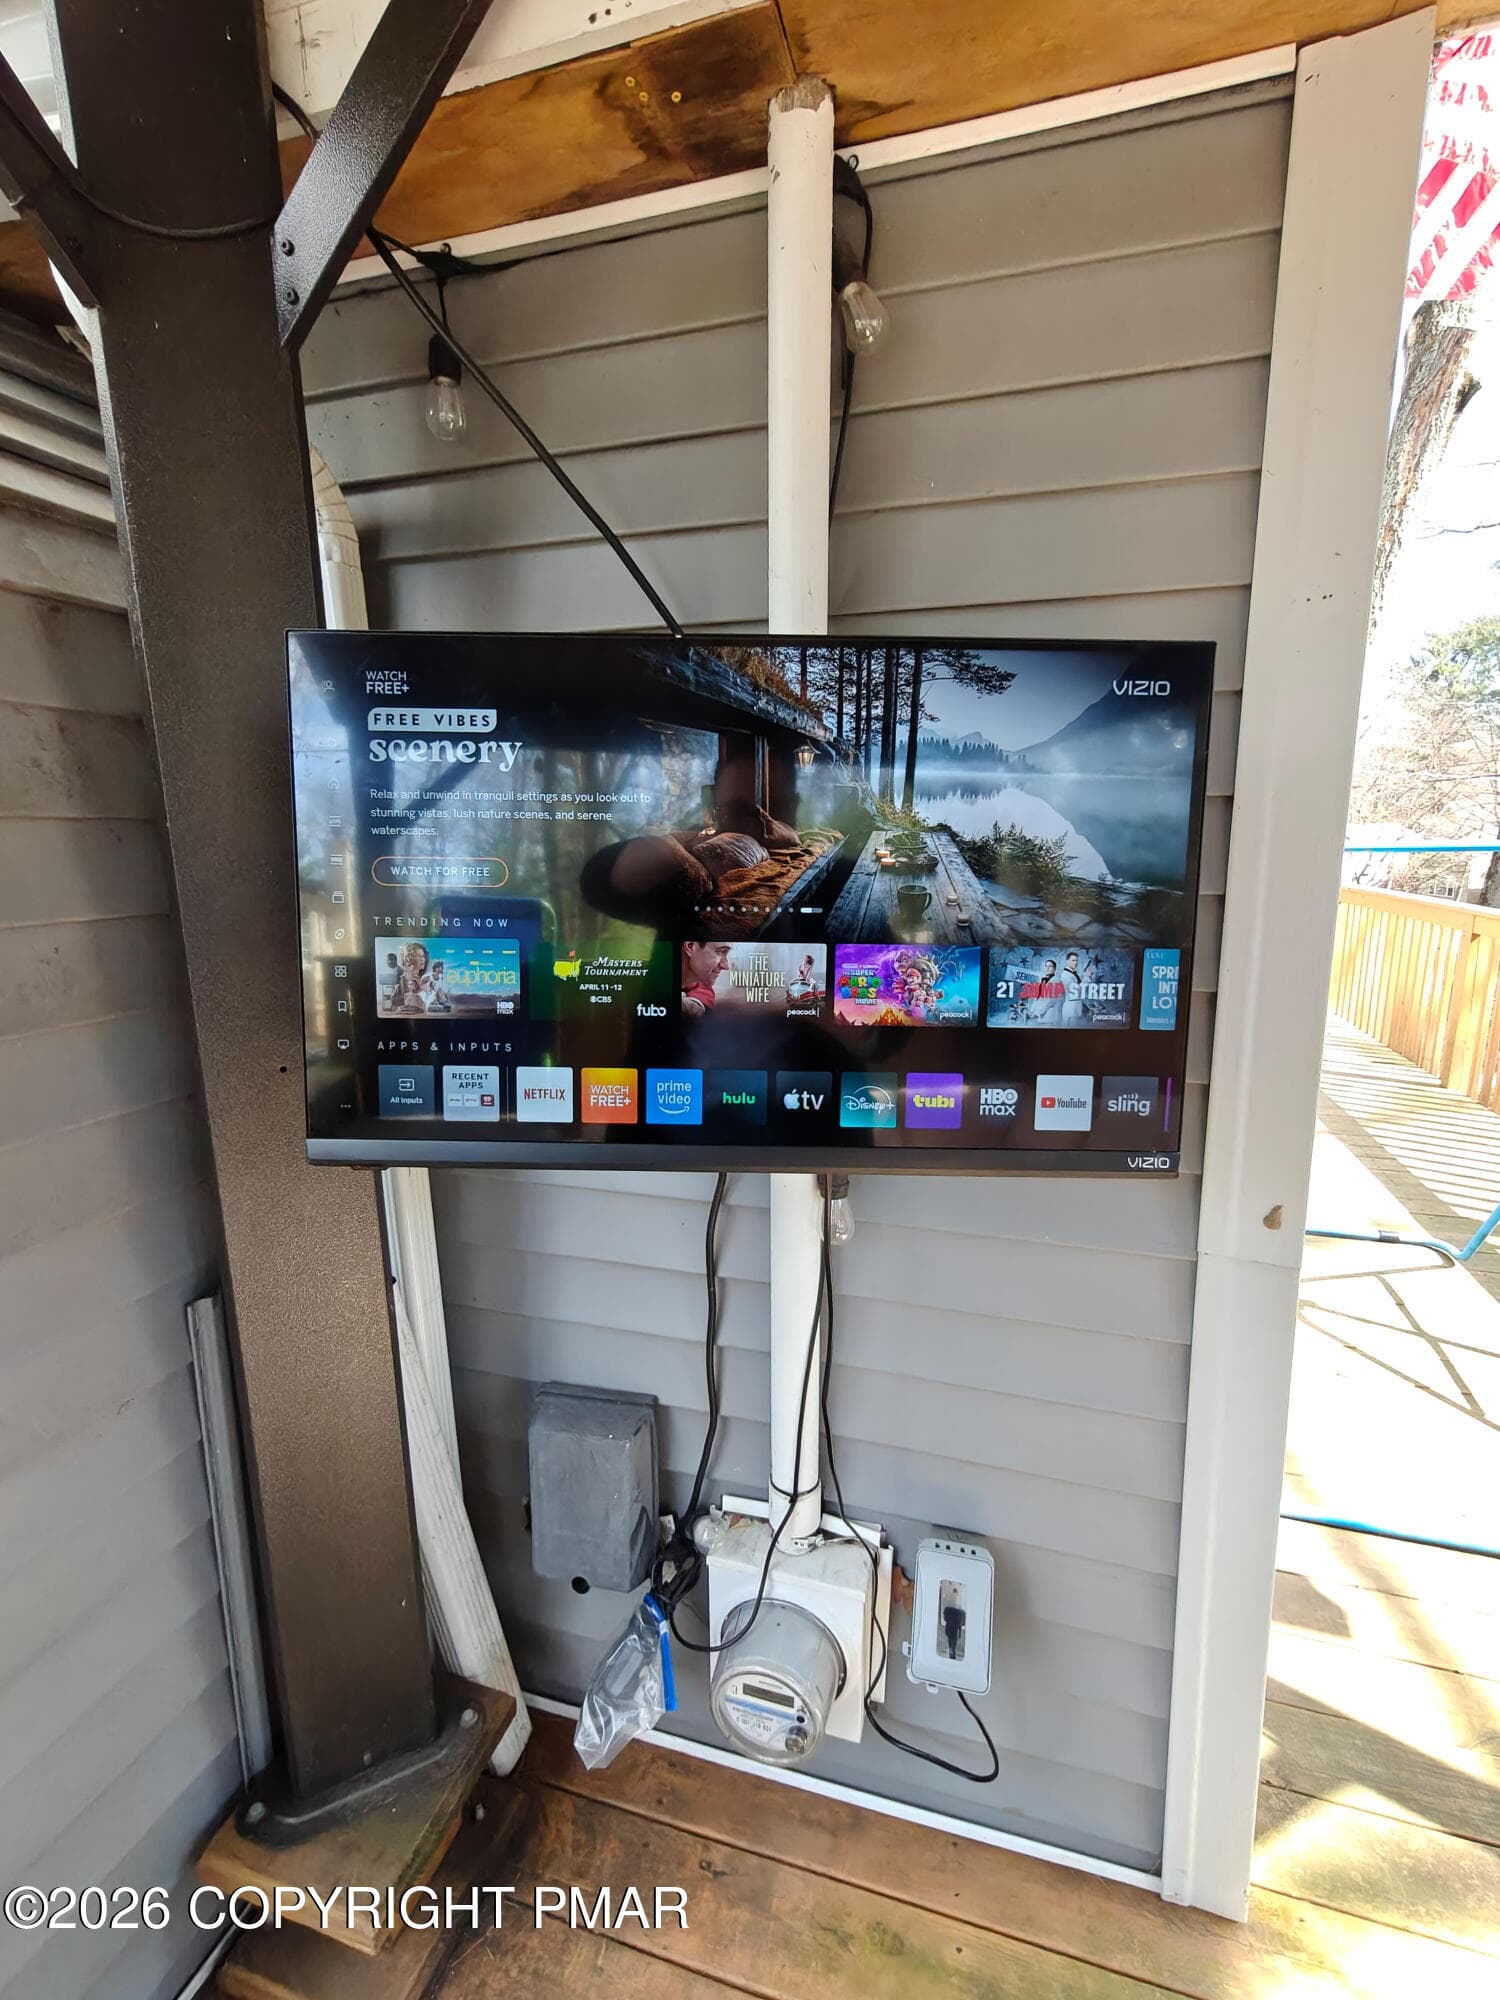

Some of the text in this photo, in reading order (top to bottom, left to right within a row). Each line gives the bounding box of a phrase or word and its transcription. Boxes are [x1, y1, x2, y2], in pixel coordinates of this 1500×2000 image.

[365, 670, 408, 682] WATCH
[366, 681, 410, 695] FREE+
[1112, 680, 1171, 696] VIZIO
[373, 713, 490, 727] FREE VIBES
[368, 738, 523, 772] scenery
[370, 789, 651, 804] Relax and unwind in tranquil settings as you look out to
[370, 807, 612, 821] stunning vistas, lush nature scenes, and serene
[371, 825, 439, 837] waterscapes.
[391, 866, 490, 877] WATCH FOR FREE
[373, 916, 509, 928] TRENDING NOW
[748, 956, 769, 971] THE
[445, 966, 517, 986] euphoria
[729, 971, 786, 987] MINIATURE
[579, 983, 599, 991] APRIL
[996, 981, 1125, 1000] 21 JUMP STREET
[745, 987, 770, 1003] WIFE
[496, 1001, 514, 1009] HBO
[636, 1003, 667, 1017] fubo
[786, 1008, 817, 1018] peacock
[939, 1010, 970, 1020] peacock
[1092, 1013, 1123, 1023] peacock
[377, 1041, 513, 1052] APPS & INPUTS
[451, 1072, 490, 1081] RECENT
[458, 1081, 484, 1089] APPS
[590, 1085, 629, 1095] WATCH
[656, 1079, 692, 1094] prime
[390, 1096, 423, 1105] All Inputs
[523, 1087, 566, 1101] NETFLIX
[657, 1092, 692, 1105] video
[722, 1091, 756, 1105] hulu
[801, 1090, 824, 1110] tv
[979, 1088, 1019, 1104] HBO
[590, 1095, 631, 1107] FREE+
[912, 1094, 955, 1108] tubi
[1056, 1097, 1087, 1109] YouTube
[1107, 1093, 1151, 1116] sling
[979, 1104, 1016, 1116] max
[1127, 1157, 1170, 1169] VIZIO
